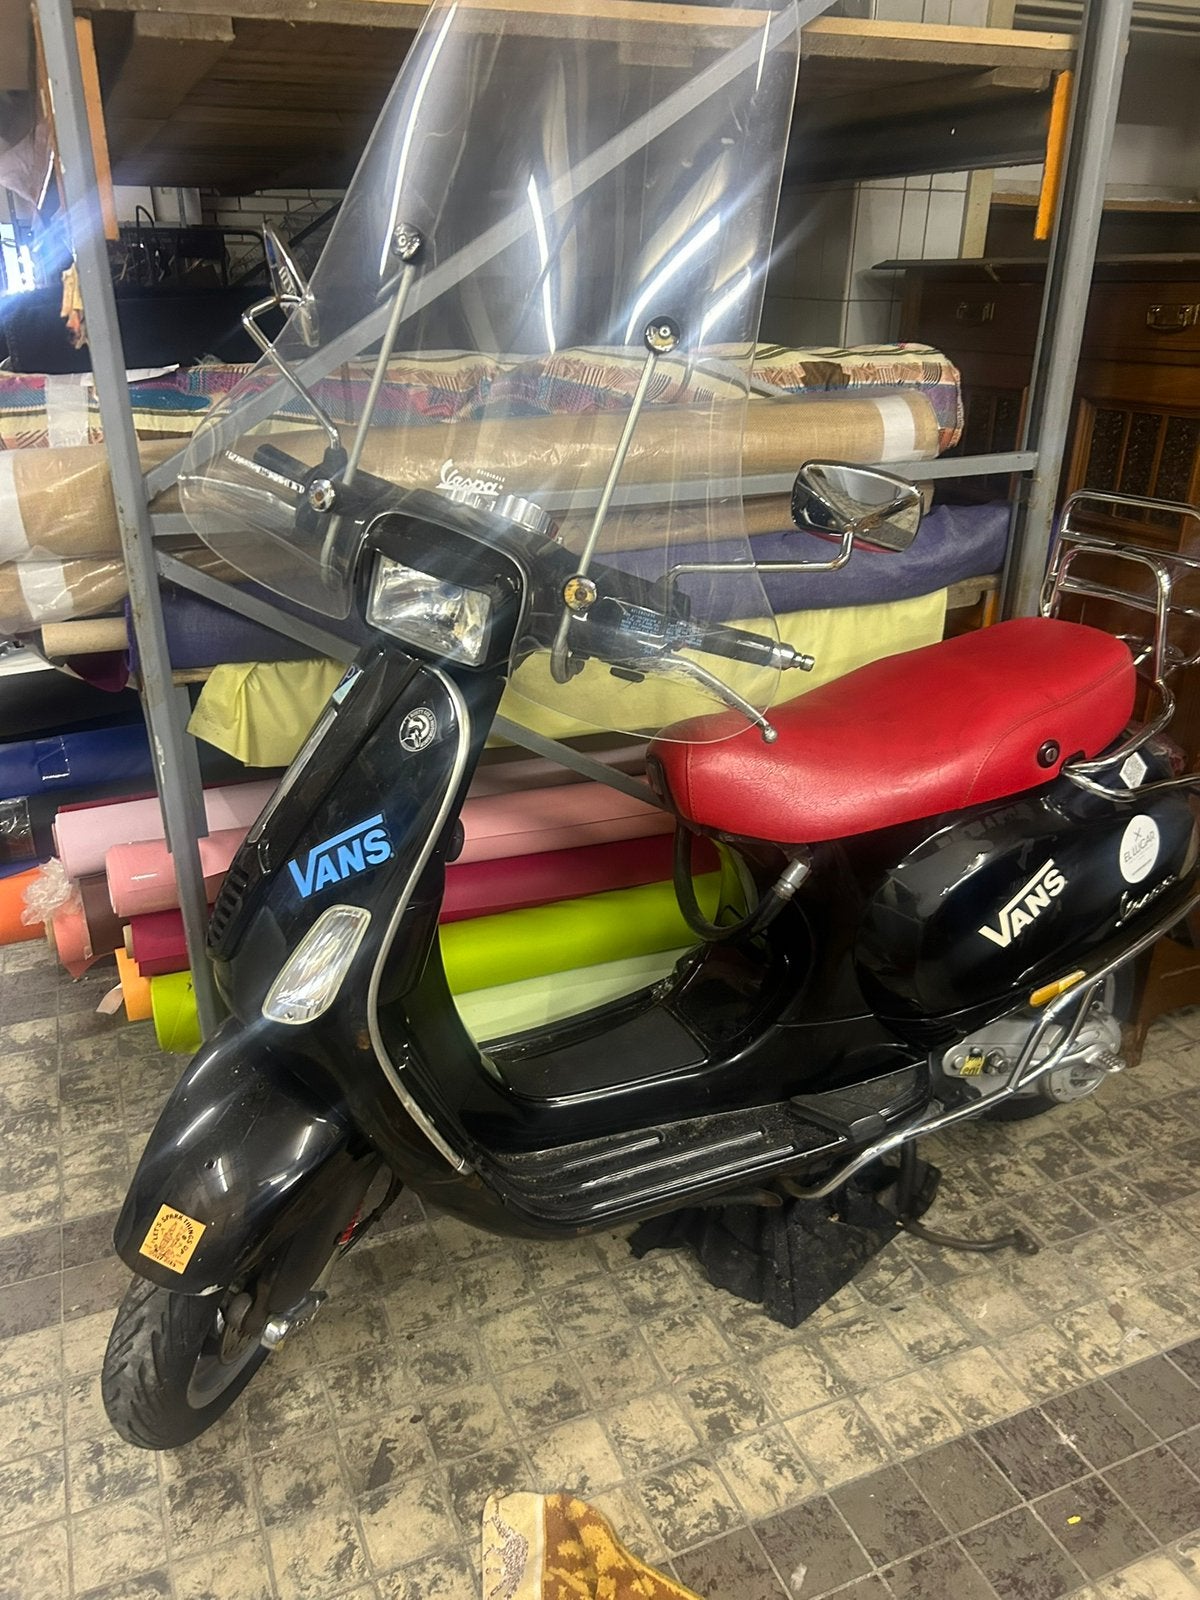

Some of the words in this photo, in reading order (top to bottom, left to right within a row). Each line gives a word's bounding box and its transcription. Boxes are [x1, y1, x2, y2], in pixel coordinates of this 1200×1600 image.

[435, 459, 499, 496] Vespa
[287, 813, 392, 898] VANS
[978, 858, 1067, 949] VANS
